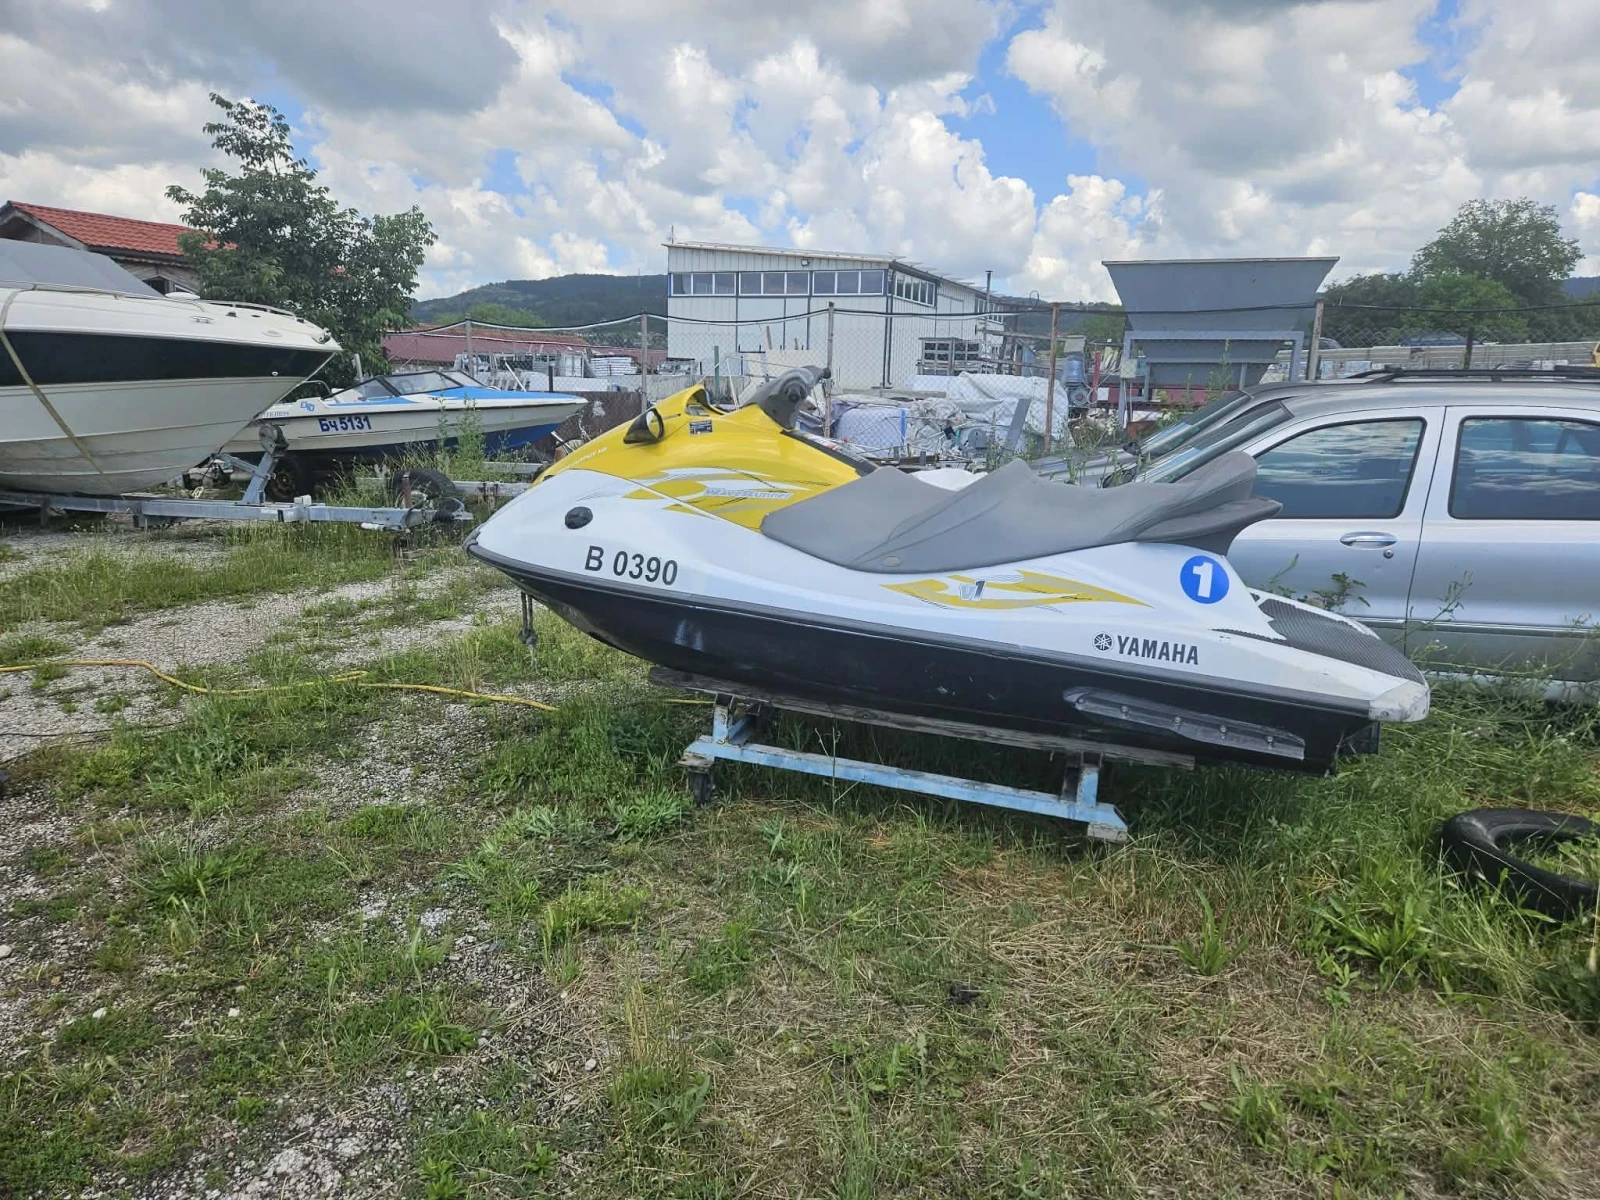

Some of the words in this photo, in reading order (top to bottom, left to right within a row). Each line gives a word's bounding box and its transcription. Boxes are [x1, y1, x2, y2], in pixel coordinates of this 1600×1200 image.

[584, 545, 604, 572] B
[613, 550, 678, 586] 0390
[1192, 561, 1213, 599] 1
[1117, 635, 1198, 665] YAMAHA
